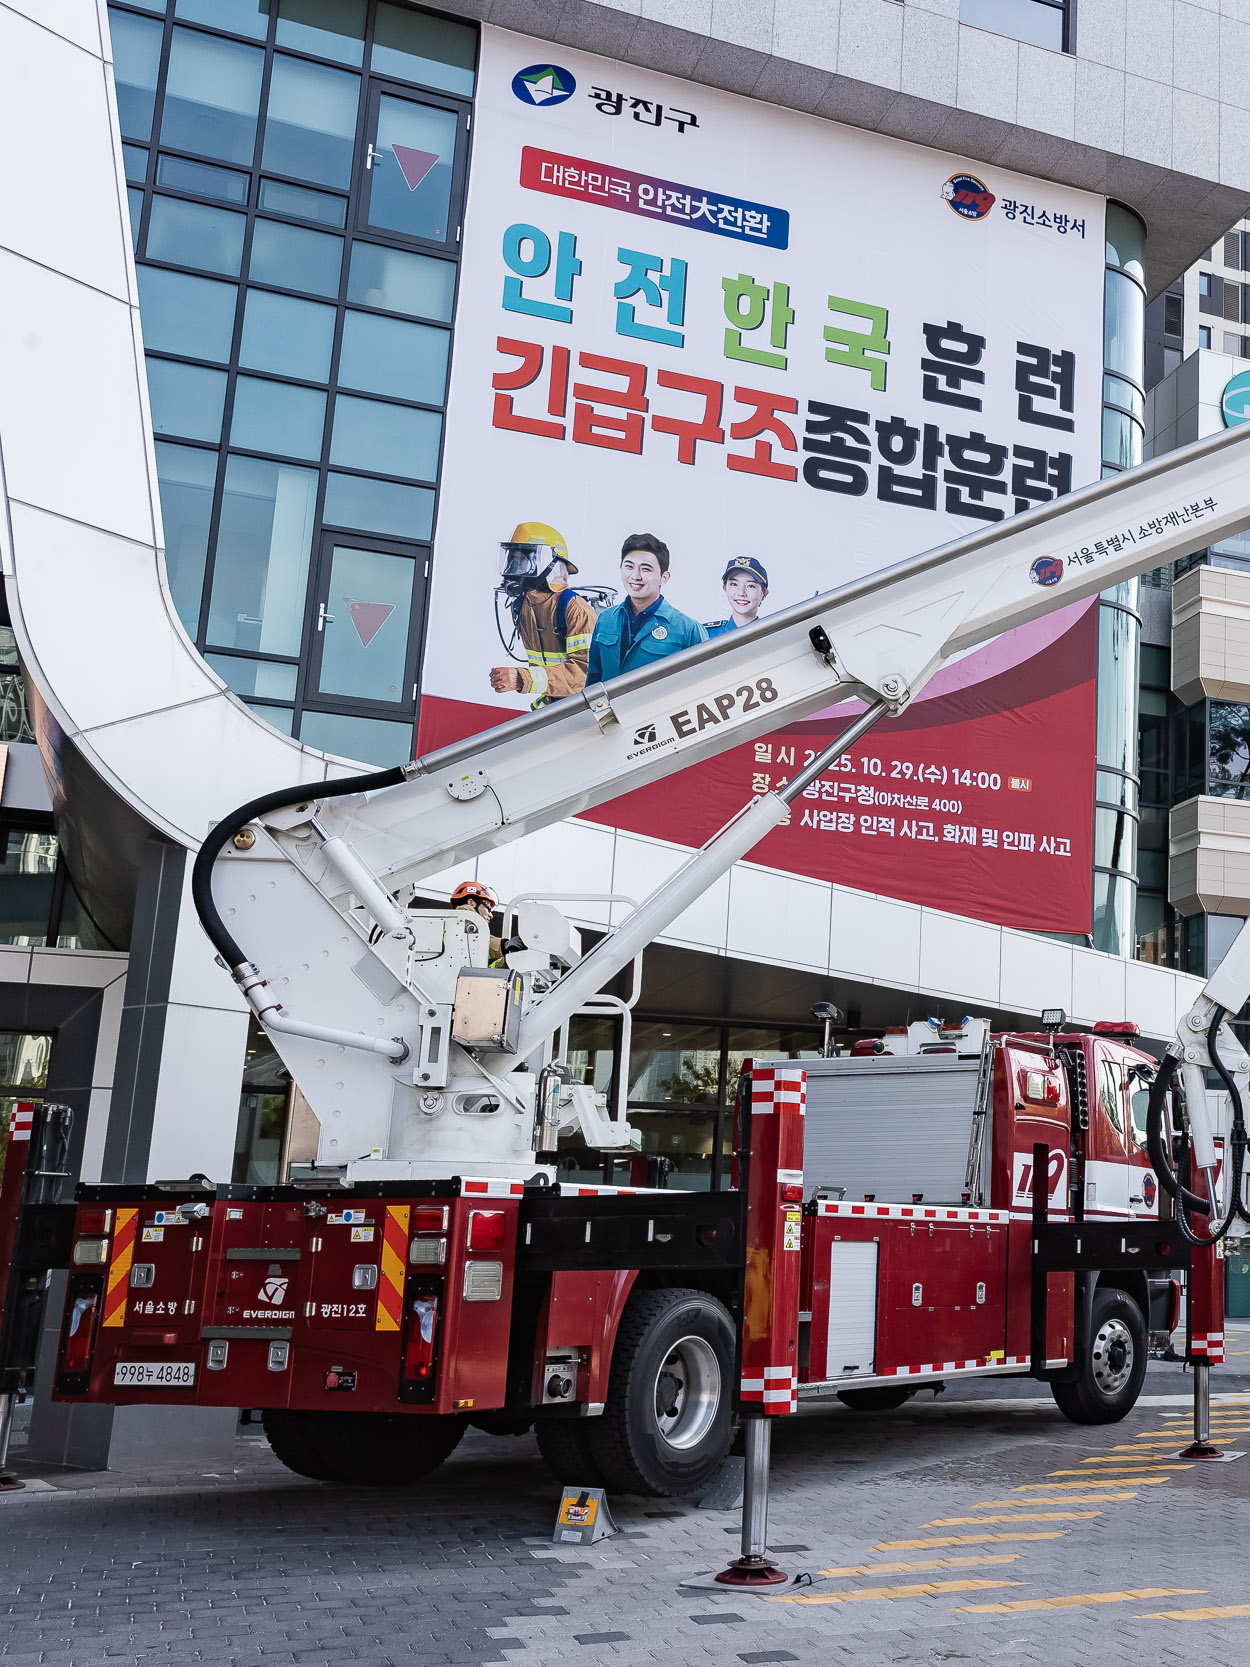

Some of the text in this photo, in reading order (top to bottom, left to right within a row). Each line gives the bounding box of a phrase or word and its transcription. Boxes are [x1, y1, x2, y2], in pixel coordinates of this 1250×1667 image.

[588, 86, 700, 134] 광진구
[540, 161, 771, 239] 대한민국 안전大전환
[952, 189, 996, 213] 119
[1000, 198, 1086, 240] 광진소방서
[1067, 497, 1219, 567] 서울특별시 소방재난본부
[670, 677, 779, 740] EAP28
[626, 737, 676, 761] EVERDIGM
[860, 757, 886, 777] 10.
[890, 760, 948, 786] 29.(수)
[951, 768, 1002, 791] 14:00
[931, 798, 963, 815] 400)
[800, 809, 856, 833] 사업장
[859, 815, 896, 837] 인적
[899, 819, 939, 843] 사고,
[942, 823, 977, 847] 화재
[981, 828, 999, 849] 및
[1002, 831, 1036, 853] 인파
[1038, 835, 1072, 857] 사고
[1015, 1152, 1065, 1201] 19
[133, 1301, 178, 1315] 서울소방
[320, 1303, 367, 1318] 광진12호
[120, 1365, 190, 1383] 998누 4848
